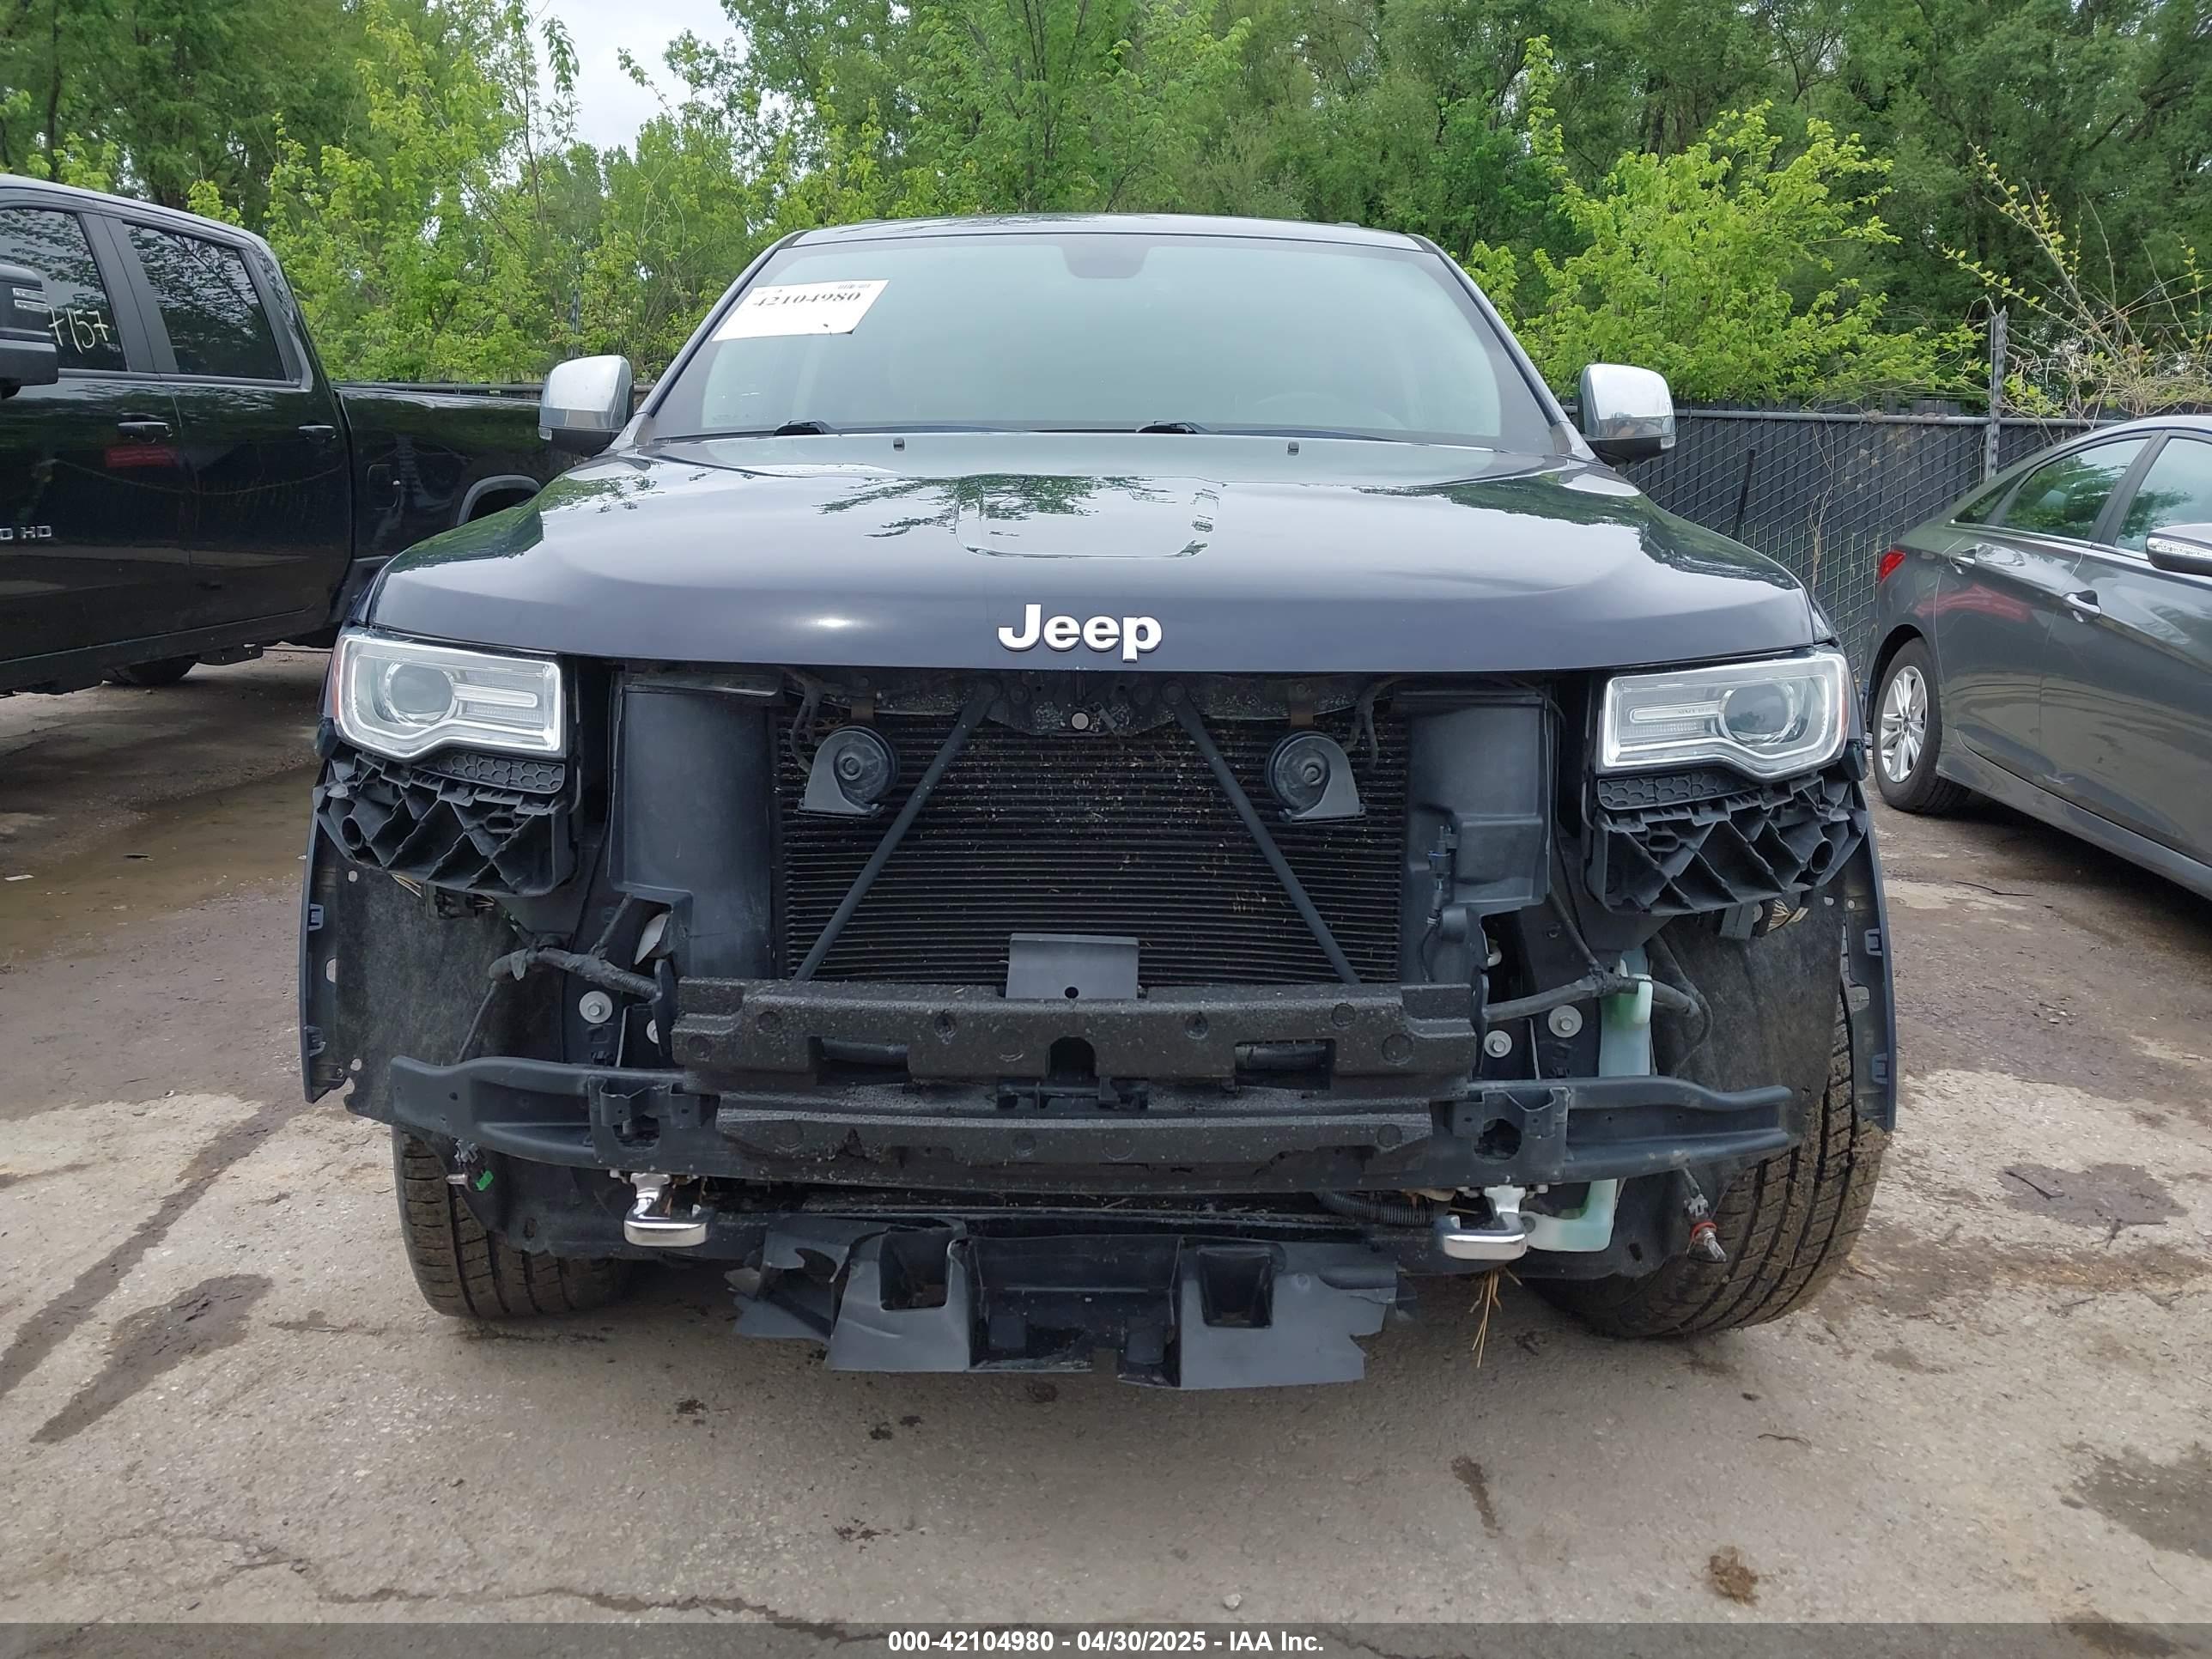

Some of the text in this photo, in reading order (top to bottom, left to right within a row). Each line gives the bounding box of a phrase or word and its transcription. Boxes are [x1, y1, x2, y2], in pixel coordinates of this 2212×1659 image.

[753, 292, 861, 307] 42104980
[20, 526, 52, 539] HD
[997, 603, 1164, 664] Jeep
